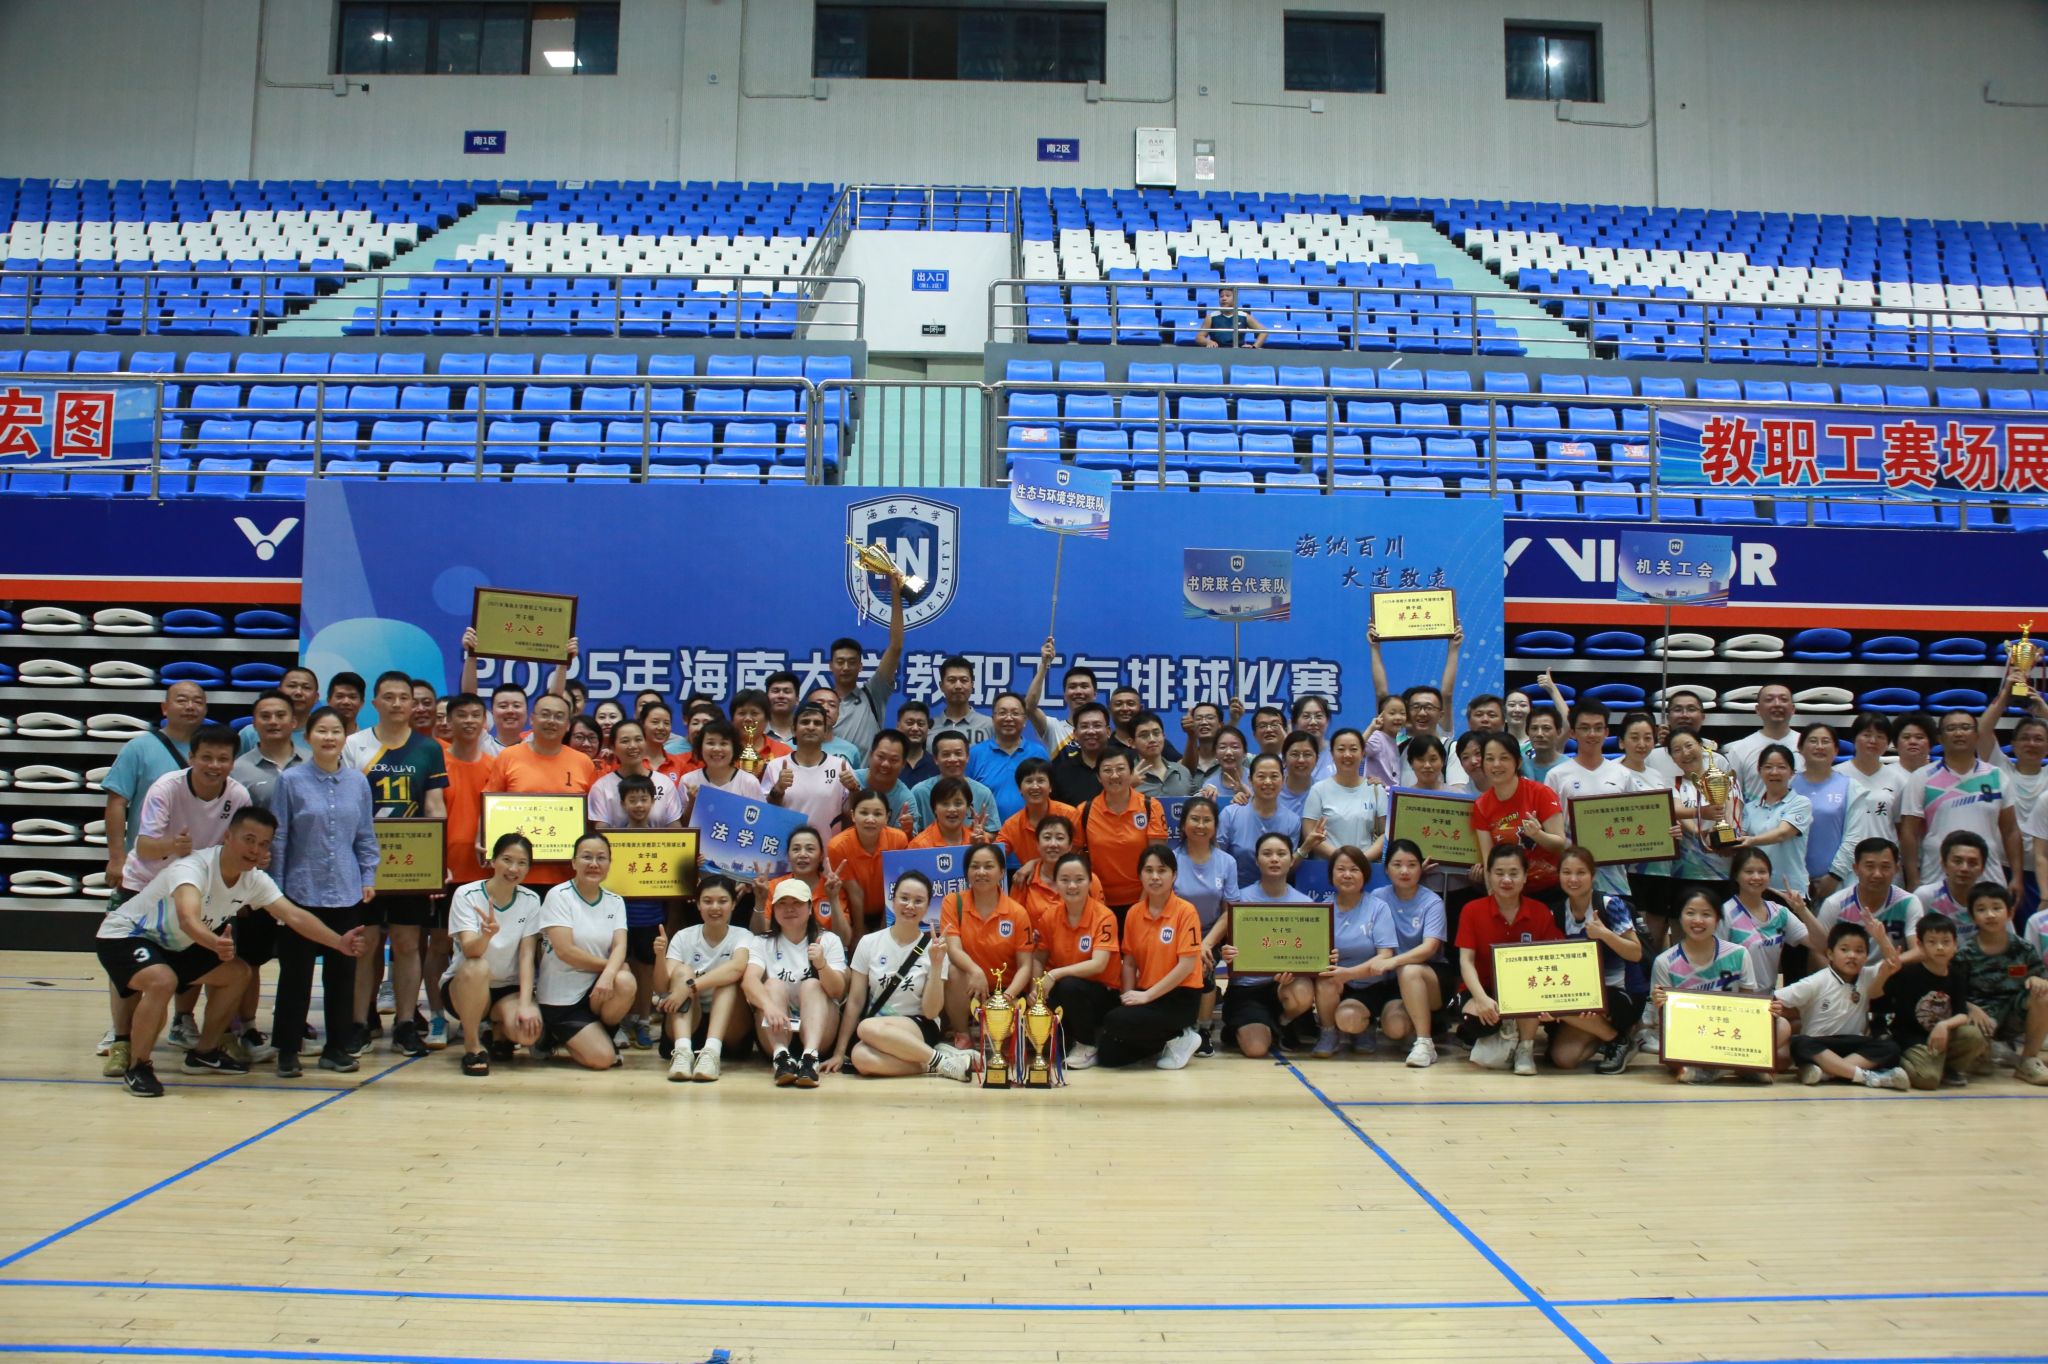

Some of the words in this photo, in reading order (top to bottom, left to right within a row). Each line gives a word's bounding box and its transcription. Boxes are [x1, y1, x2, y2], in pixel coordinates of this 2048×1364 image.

[1046, 143, 1071, 153] 南2区
[916, 272, 945, 282] 出入口
[0, 386, 116, 459] 宏图
[1699, 414, 2048, 493] 教职工赛场展
[1016, 483, 1106, 512] 生态与环境学院联队
[866, 504, 942, 521] 海南大学
[1295, 532, 1406, 561] 海纳百川
[1636, 558, 1714, 578] 机关工会
[878, 539, 952, 623] UIVERSITY
[1187, 575, 1288, 594] 书院联合代表队
[566, 772, 572, 787] 1
[824, 768, 836, 779] 10
[376, 776, 407, 799] 11
[223, 800, 231, 812] 6
[1827, 793, 1842, 803] 15
[711, 822, 780, 856] 法学院
[1422, 826, 1462, 841] 第八名
[1605, 824, 1645, 839] 第四名
[628, 862, 669, 874] 第五名
[1101, 925, 1112, 943] 5
[1262, 936, 1302, 949] 第四名
[133, 946, 151, 963] 3
[1527, 974, 1571, 989] 第六名
[1697, 1025, 1742, 1040] 第七名
